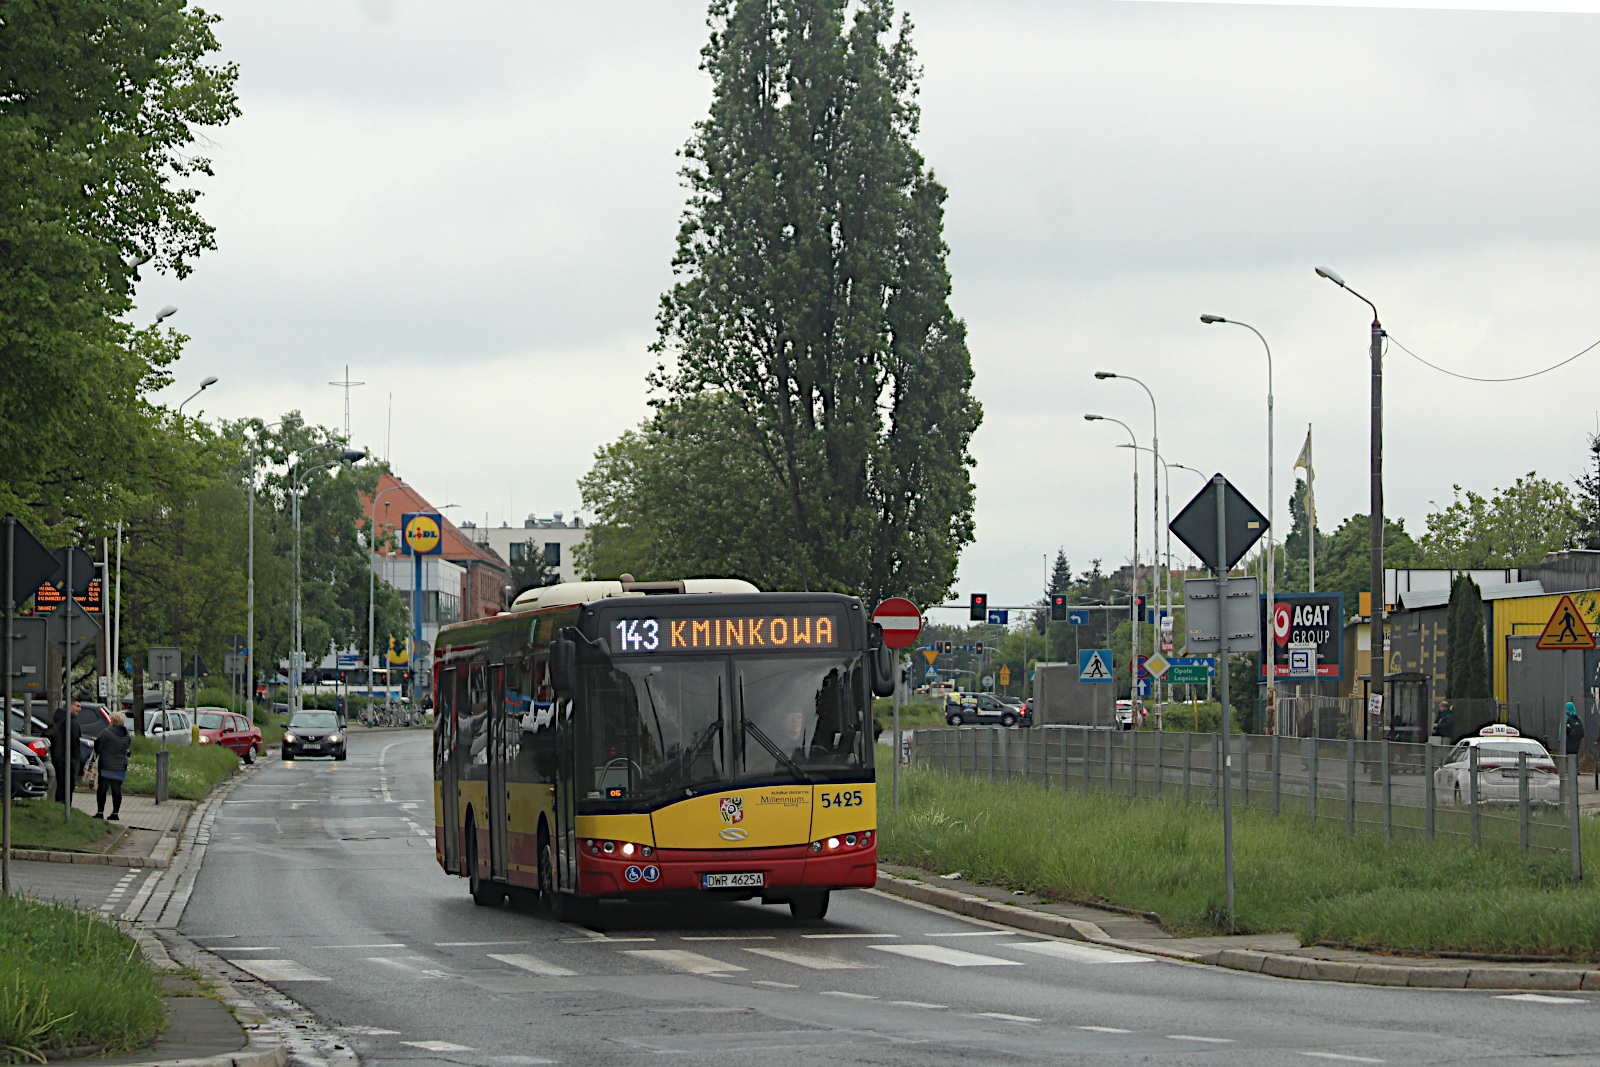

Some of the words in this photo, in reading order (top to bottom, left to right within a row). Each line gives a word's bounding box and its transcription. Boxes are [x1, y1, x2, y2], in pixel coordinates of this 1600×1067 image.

[1293, 605, 1330, 627] AGAT
[616, 619, 659, 650] 143
[670, 617, 832, 647] KMINKOWA
[1293, 630, 1330, 644] GROUP
[760, 795, 804, 804] Millennium
[821, 790, 863, 808] 5425
[710, 850, 754, 859] SOLARIS
[708, 875, 728, 886] DWR
[731, 874, 763, 885] 4625A
